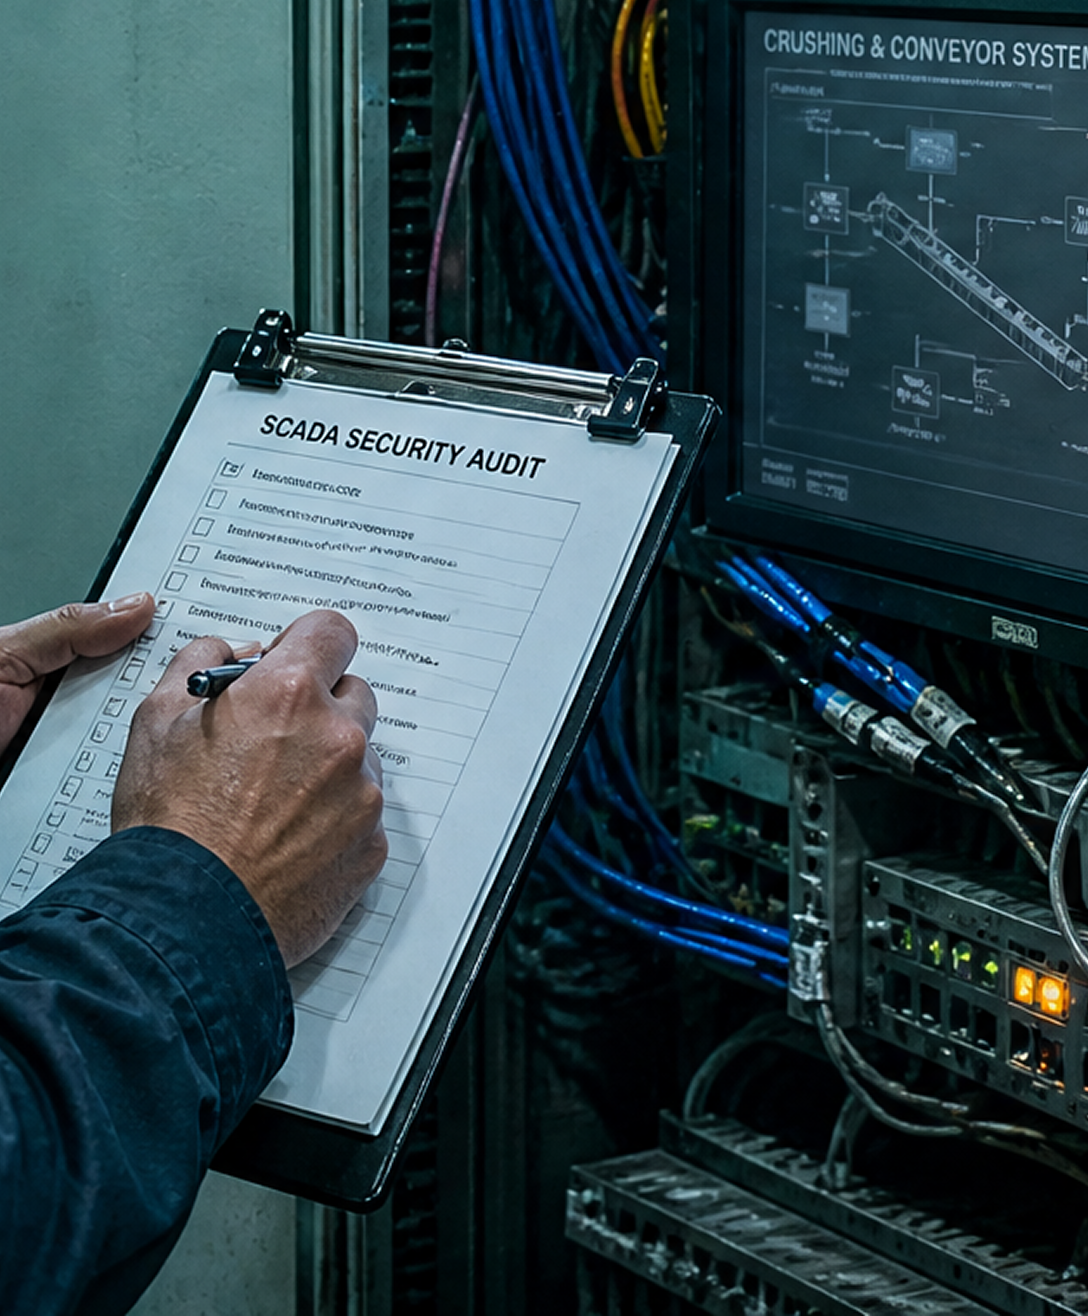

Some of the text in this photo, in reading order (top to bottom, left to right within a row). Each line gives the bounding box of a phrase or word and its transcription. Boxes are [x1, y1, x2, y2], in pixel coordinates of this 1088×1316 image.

[764, 28, 865, 59] CRUSHING
[870, 34, 885, 59] &
[890, 35, 1006, 66] CONVEYOR
[259, 414, 547, 479] SCADA SECURITY AUDIT
